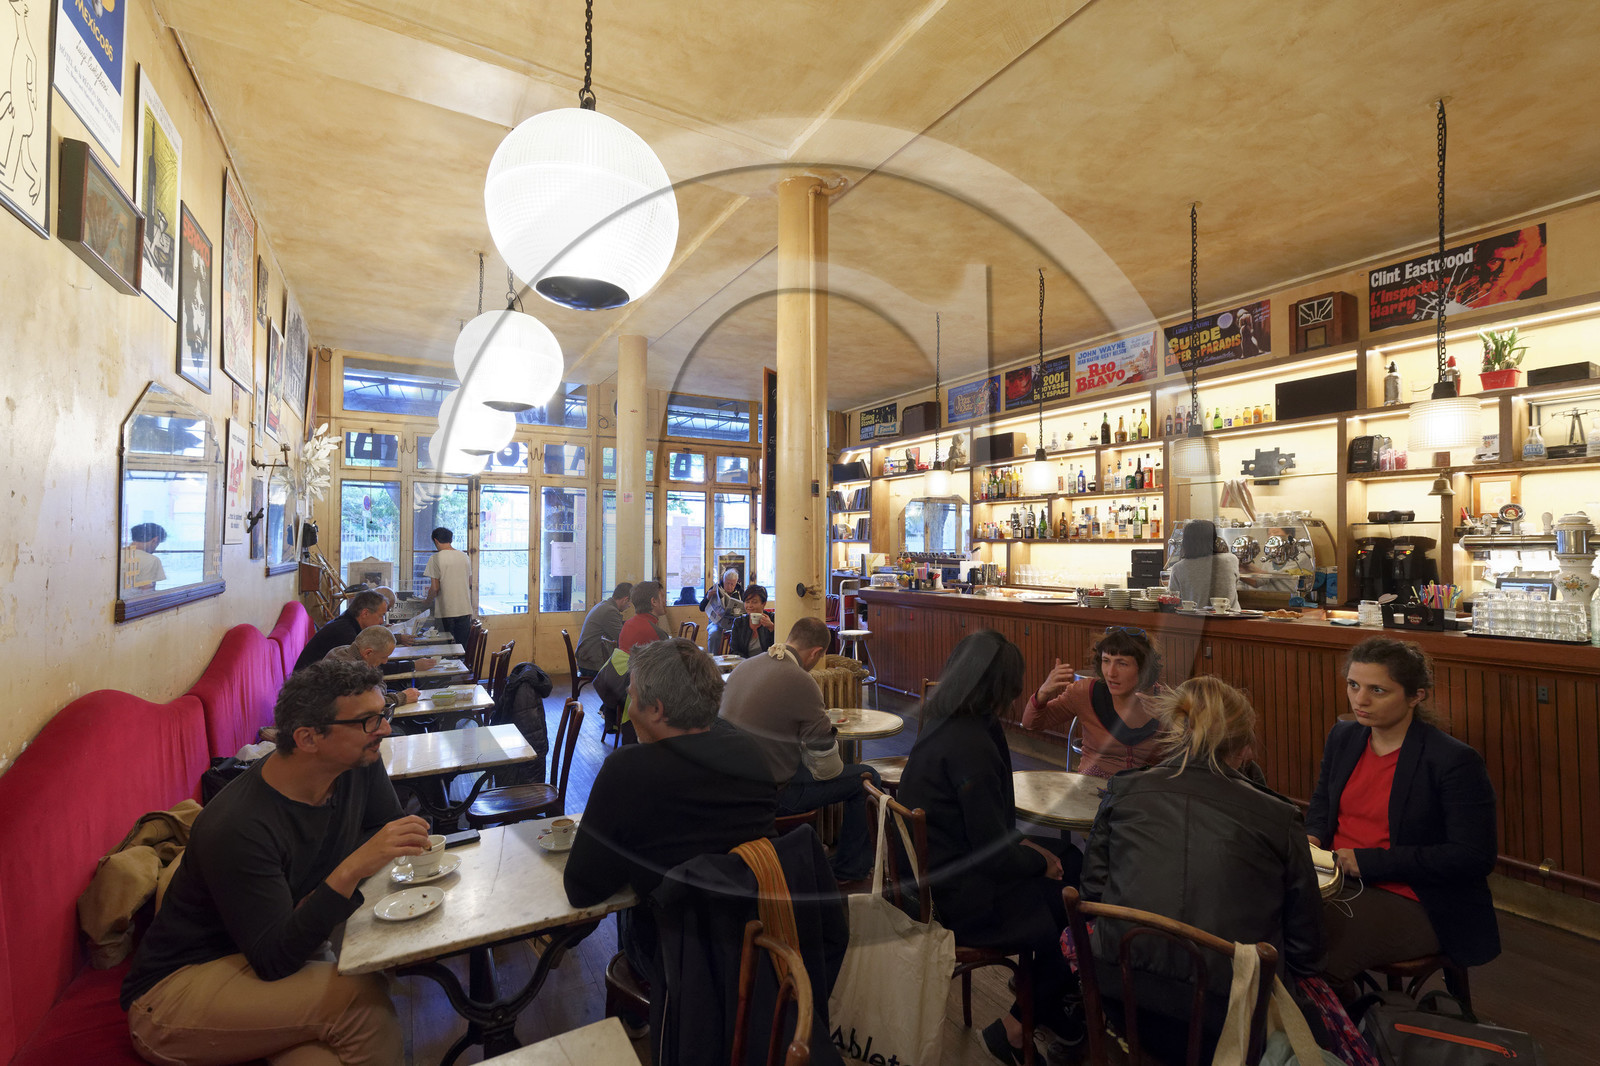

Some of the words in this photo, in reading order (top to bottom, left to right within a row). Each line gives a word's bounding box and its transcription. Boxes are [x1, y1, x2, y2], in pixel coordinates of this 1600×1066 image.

[1371, 267, 1401, 288] Clint
[1370, 299, 1417, 319] Harry
[1078, 350, 1097, 360] JOHN
[1099, 341, 1126, 354] WAYNE
[1200, 333, 1241, 357] PARADIS
[1043, 371, 1065, 387] 2001
[1087, 361, 1116, 379] RIO
[1076, 369, 1125, 393] BRAVO
[830, 1024, 911, 1066] Ablet
